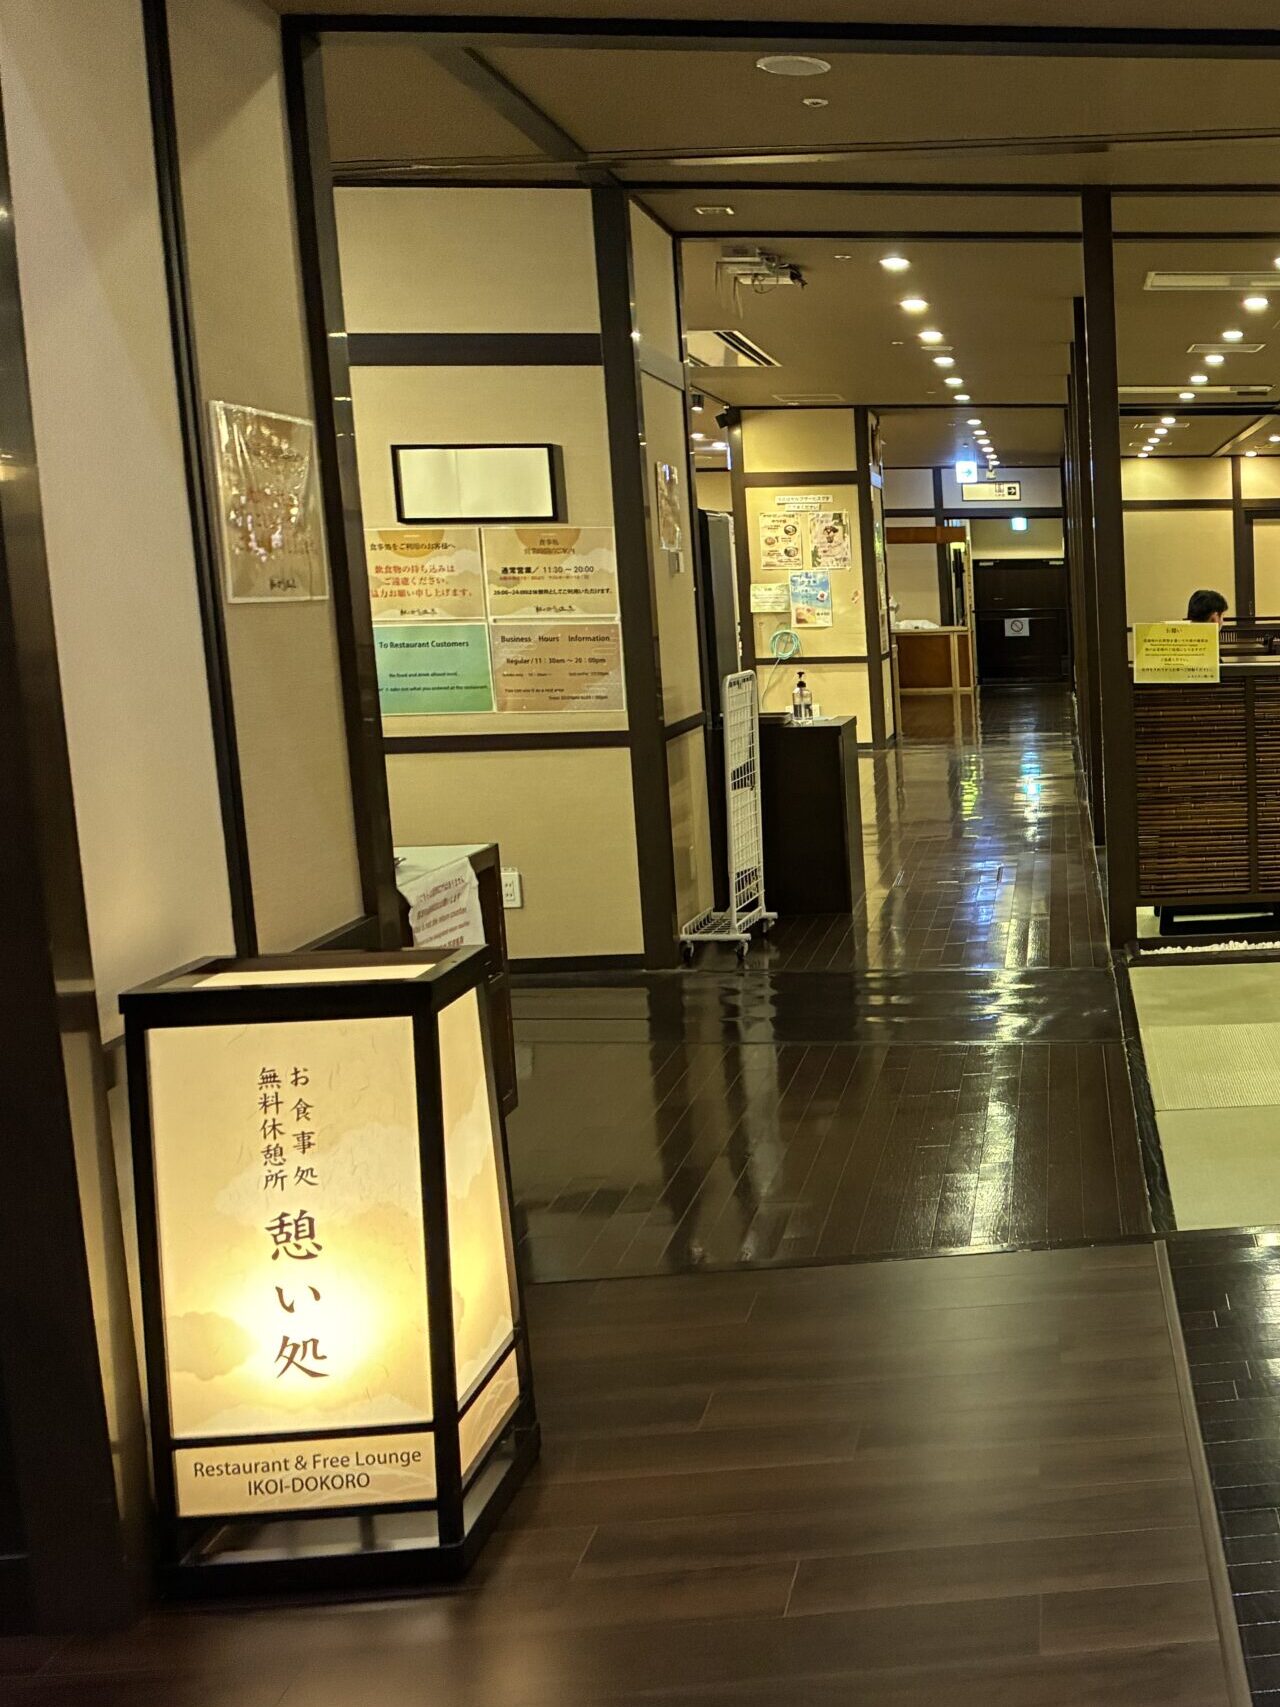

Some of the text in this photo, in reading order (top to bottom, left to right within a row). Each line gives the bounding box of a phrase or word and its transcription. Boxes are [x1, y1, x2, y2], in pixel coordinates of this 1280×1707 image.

[574, 565, 594, 573] 20:00
[379, 640, 469, 649] To Restaurant Customers
[506, 657, 530, 666] Regular
[257, 1066, 288, 1192] 無料休憩所
[289, 1065, 319, 1188] お食事処
[264, 1208, 329, 1379] 憩い処
[194, 1448, 422, 1478] Restaurant & Free Lounge
[247, 1472, 371, 1496] IKOI-DOKORO
